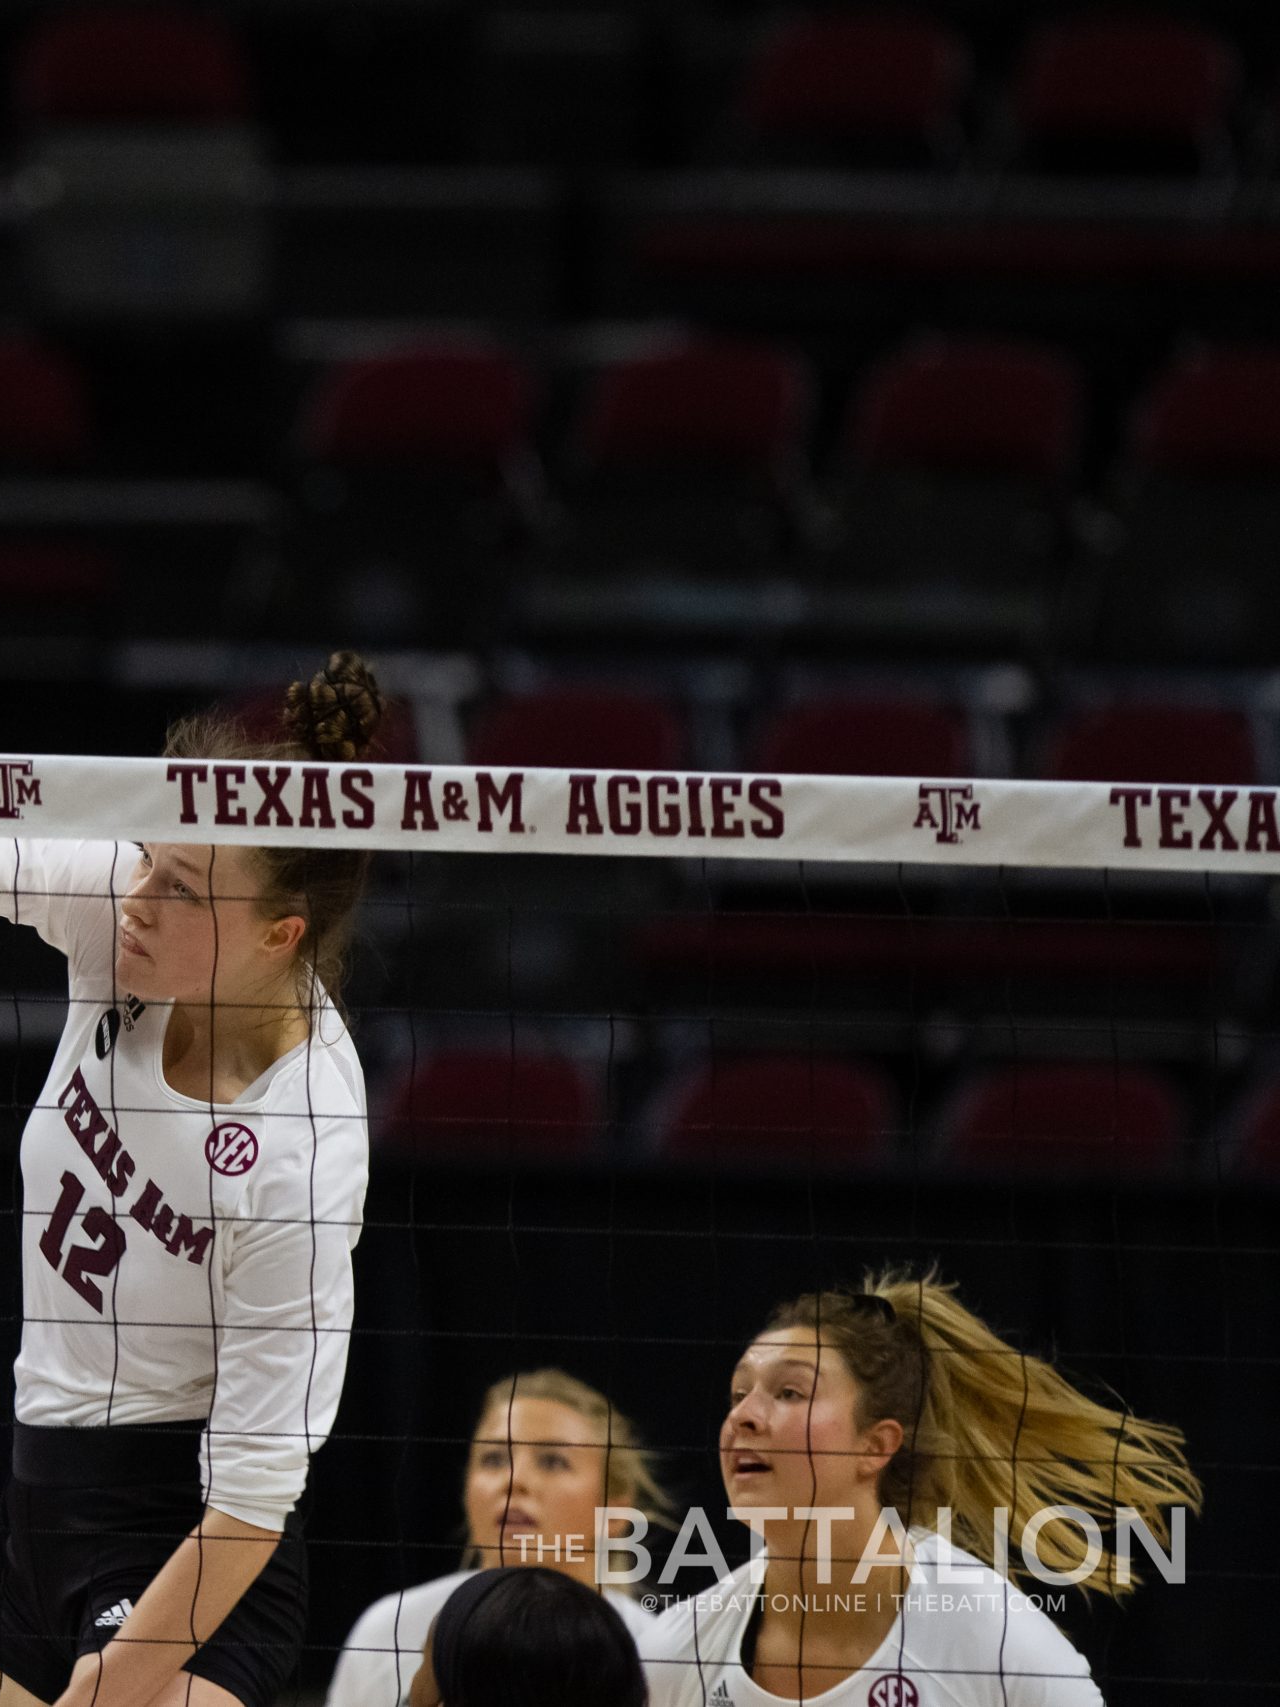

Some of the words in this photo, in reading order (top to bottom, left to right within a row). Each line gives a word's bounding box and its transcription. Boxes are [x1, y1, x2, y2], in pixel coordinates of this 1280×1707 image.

[167, 764, 375, 830] TEXAS
[401, 771, 525, 834] A&M
[566, 775, 785, 840] AGGIES
[1109, 788, 1280, 853] TEXA
[58, 1064, 135, 1197] TEXAS
[129, 1179, 215, 1265] A&M
[207, 1125, 256, 1174] SEC
[39, 1170, 127, 1314] 12
